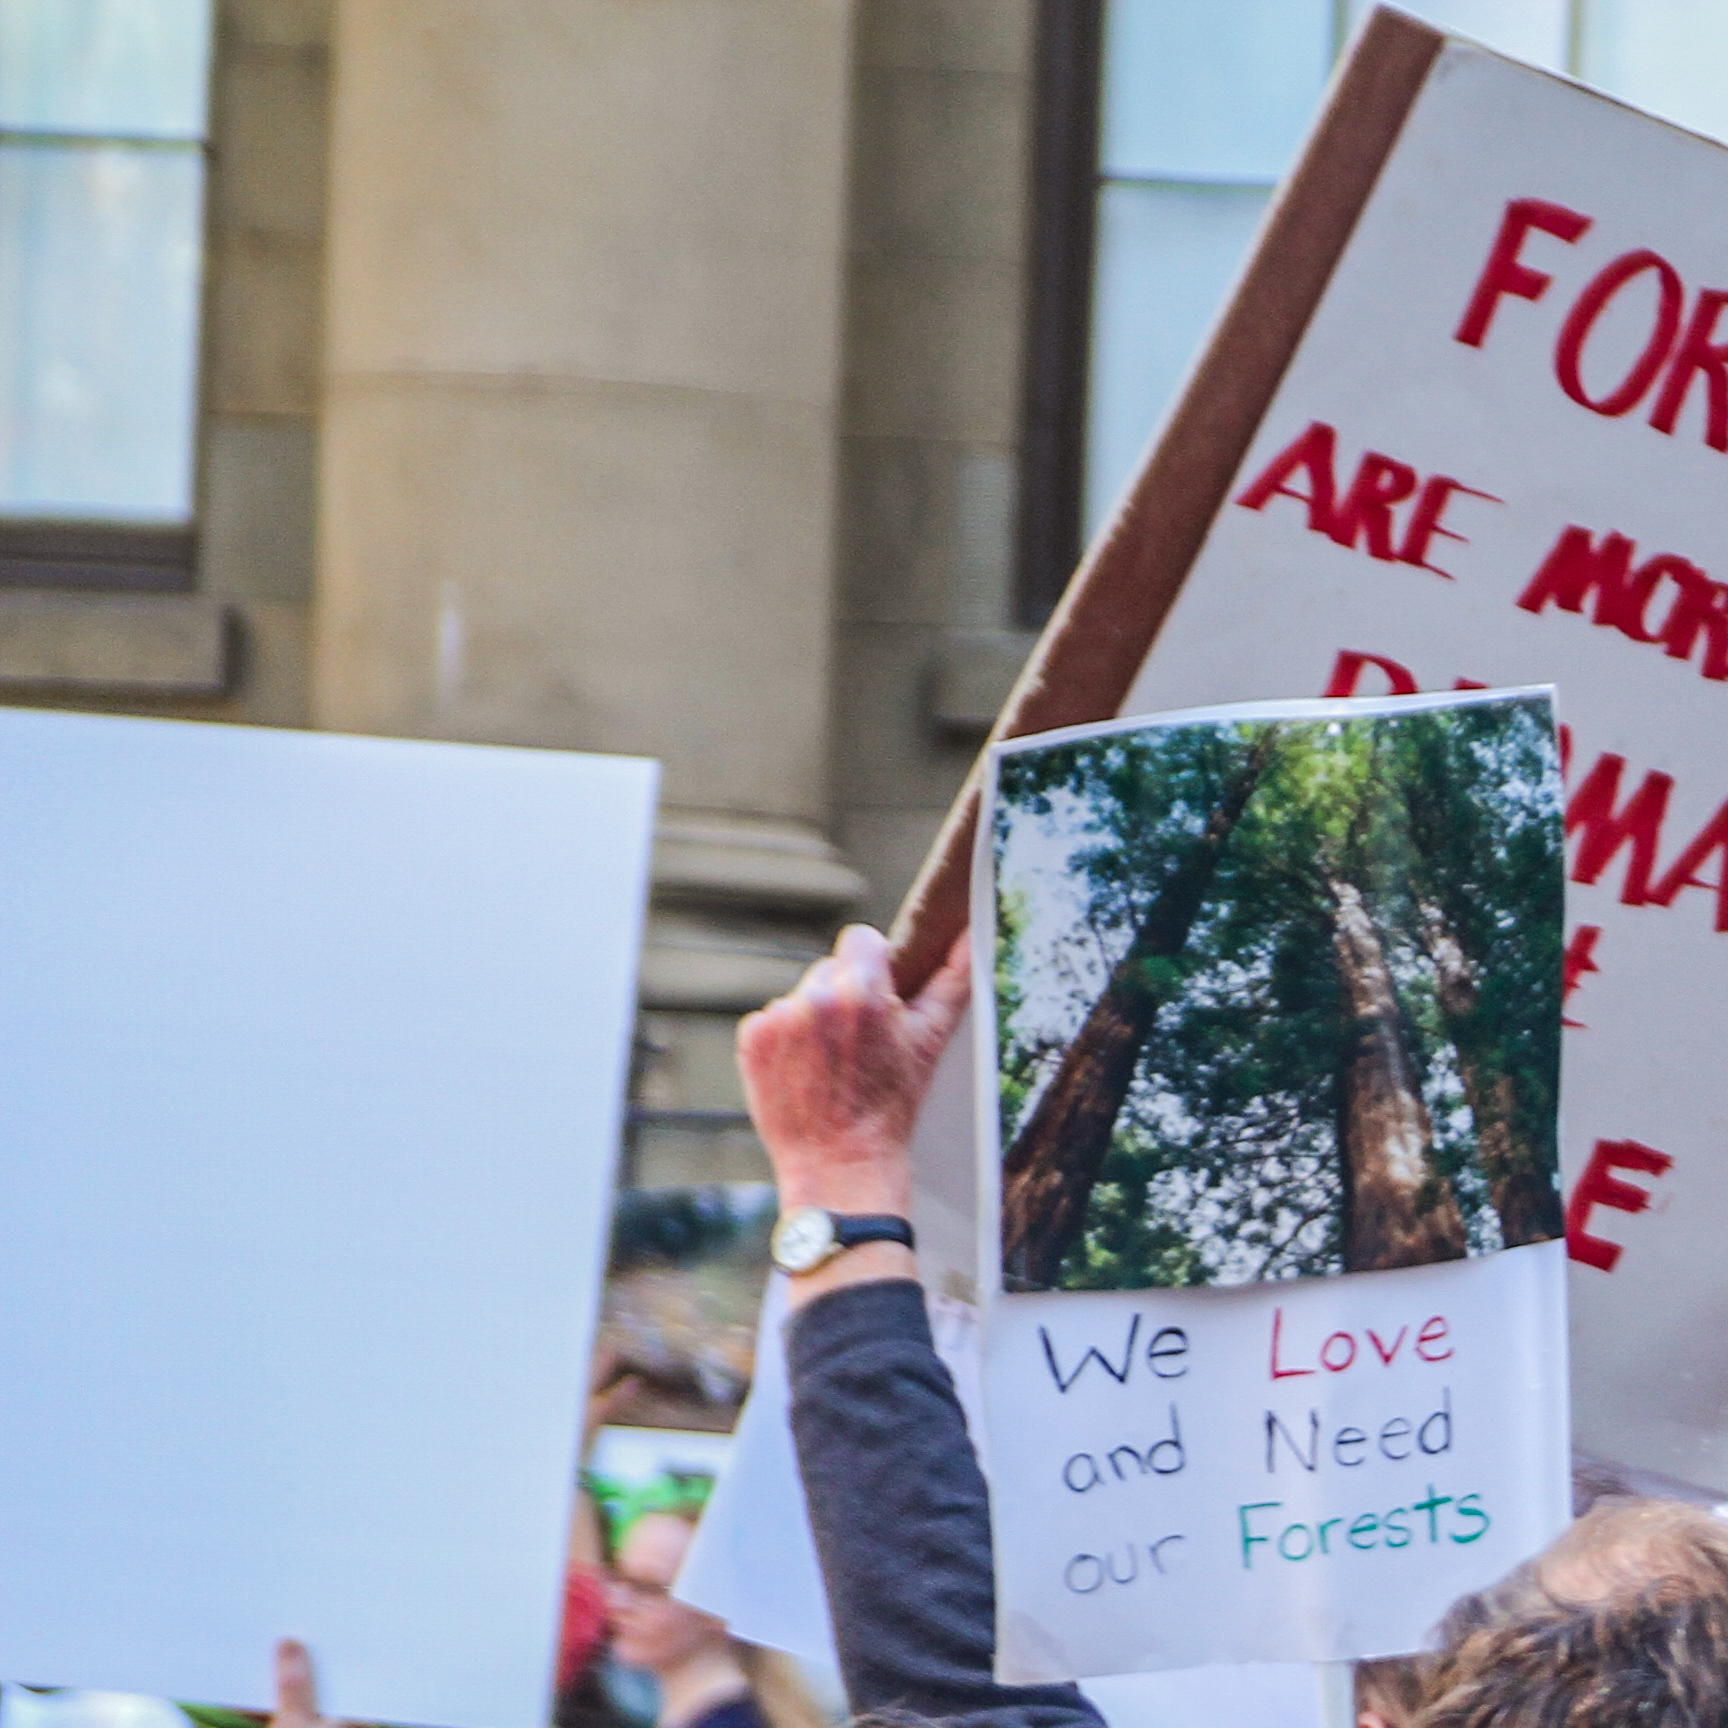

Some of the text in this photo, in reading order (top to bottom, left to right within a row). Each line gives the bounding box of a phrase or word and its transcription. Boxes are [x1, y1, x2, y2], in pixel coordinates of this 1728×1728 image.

[1234, 417, 1504, 582] ARE
[1037, 1306, 1456, 1394] We Love
[1061, 1386, 1455, 1494] and Need
[1063, 1484, 1491, 1595] our Forests
